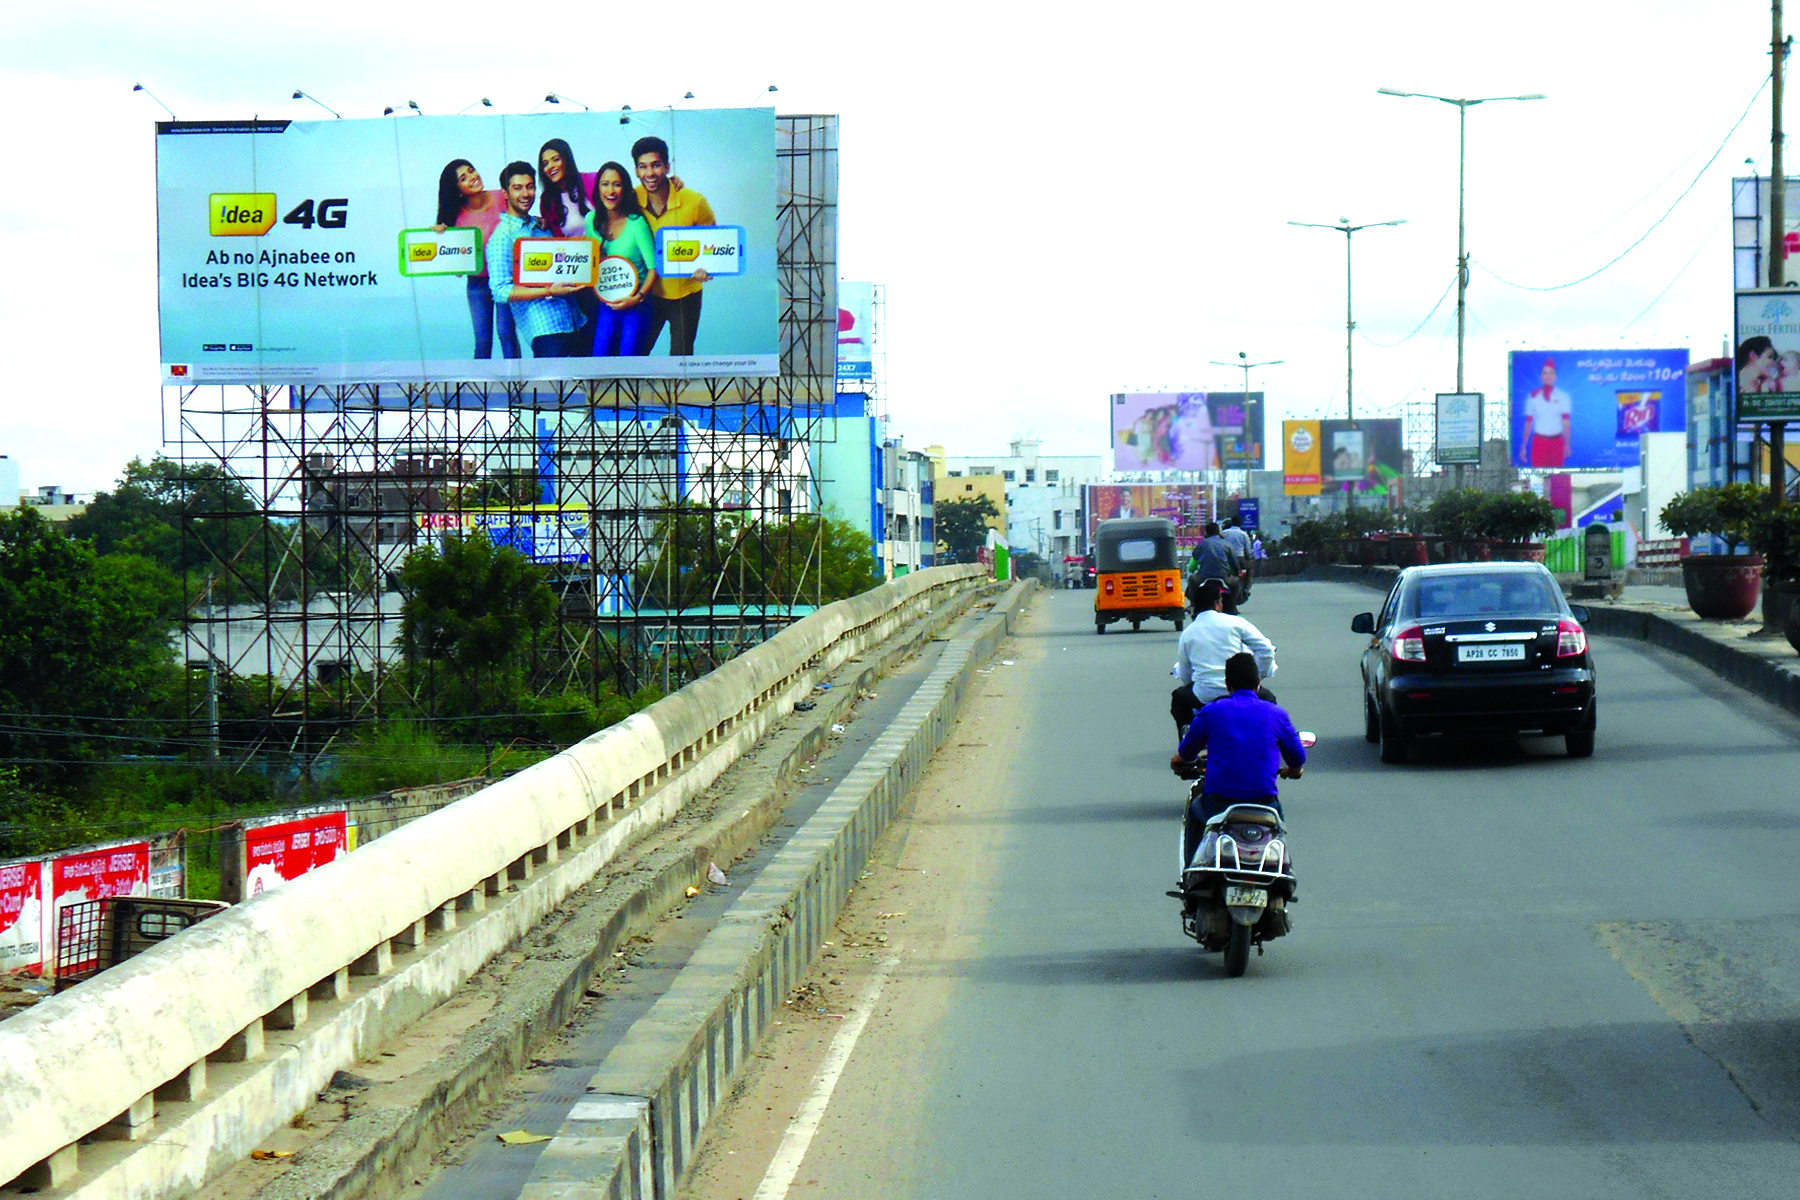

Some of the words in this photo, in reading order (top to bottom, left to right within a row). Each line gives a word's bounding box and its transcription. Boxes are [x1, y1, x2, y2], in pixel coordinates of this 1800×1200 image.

[283, 198, 348, 229] 4G
[702, 244, 736, 256] Music
[206, 250, 230, 265] Ab
[234, 252, 254, 265] no
[259, 249, 330, 268] Ajnabee
[334, 251, 356, 263] on
[555, 265, 564, 275] &
[566, 265, 579, 275] TV
[601, 266, 623, 275] 230+
[182, 273, 232, 288] Idea's
[238, 272, 269, 287] BIG
[273, 272, 299, 287] 4G
[304, 271, 378, 287] Network
[600, 274, 618, 284] LIVE
[620, 272, 630, 280] TV
[598, 282, 633, 292] Channels
[1624, 405, 1655, 430] Rin
[1594, 556, 1604, 570] 3
[291, 832, 311, 850] JERSEY
[109, 852, 136, 872] JERSEY
